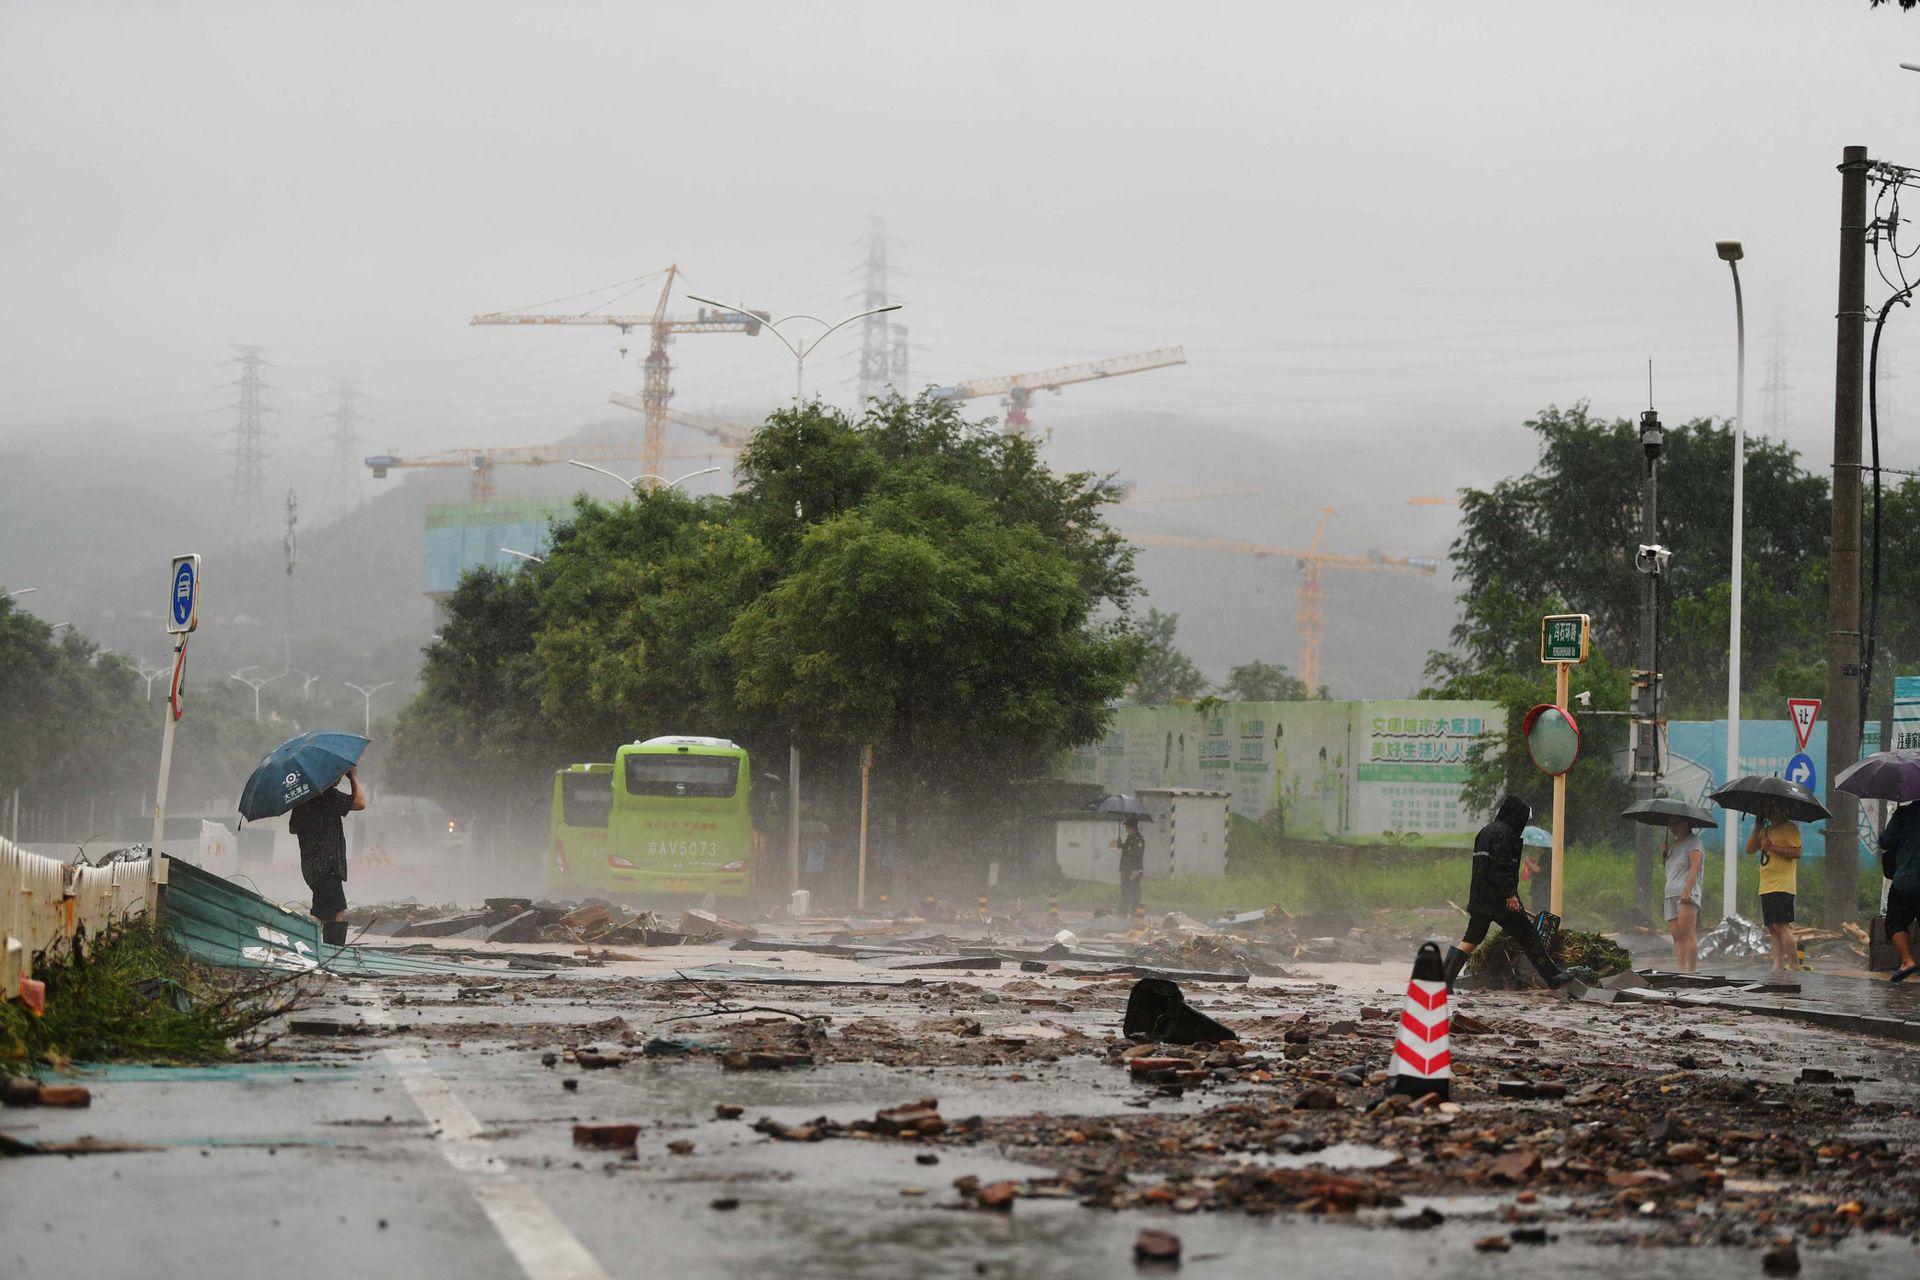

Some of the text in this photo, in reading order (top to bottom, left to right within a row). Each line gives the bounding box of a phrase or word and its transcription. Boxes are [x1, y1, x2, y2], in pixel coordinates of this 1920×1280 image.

[1799, 708, 1809, 725] 让
[1371, 741, 1481, 760] 美好生活人人
[647, 841, 717, 857] 京AV5073
